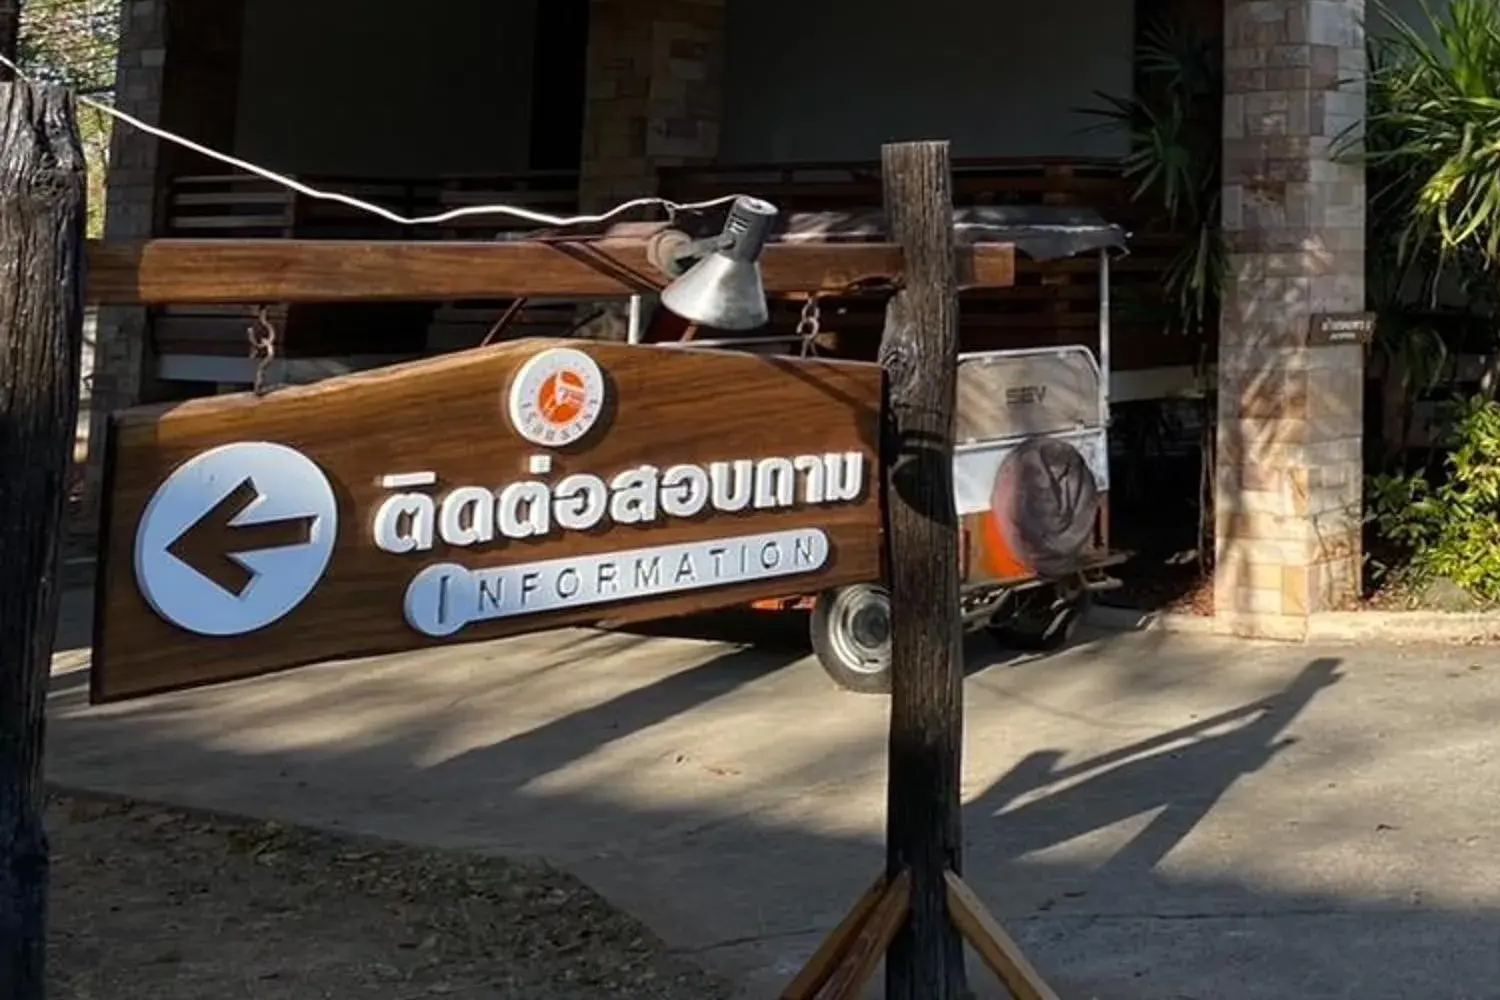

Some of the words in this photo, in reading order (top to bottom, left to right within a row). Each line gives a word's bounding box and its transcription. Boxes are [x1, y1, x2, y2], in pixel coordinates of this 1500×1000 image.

[374, 452, 862, 553] ติดต่อสอบถาม
[437, 536, 814, 625] INFORMATION
